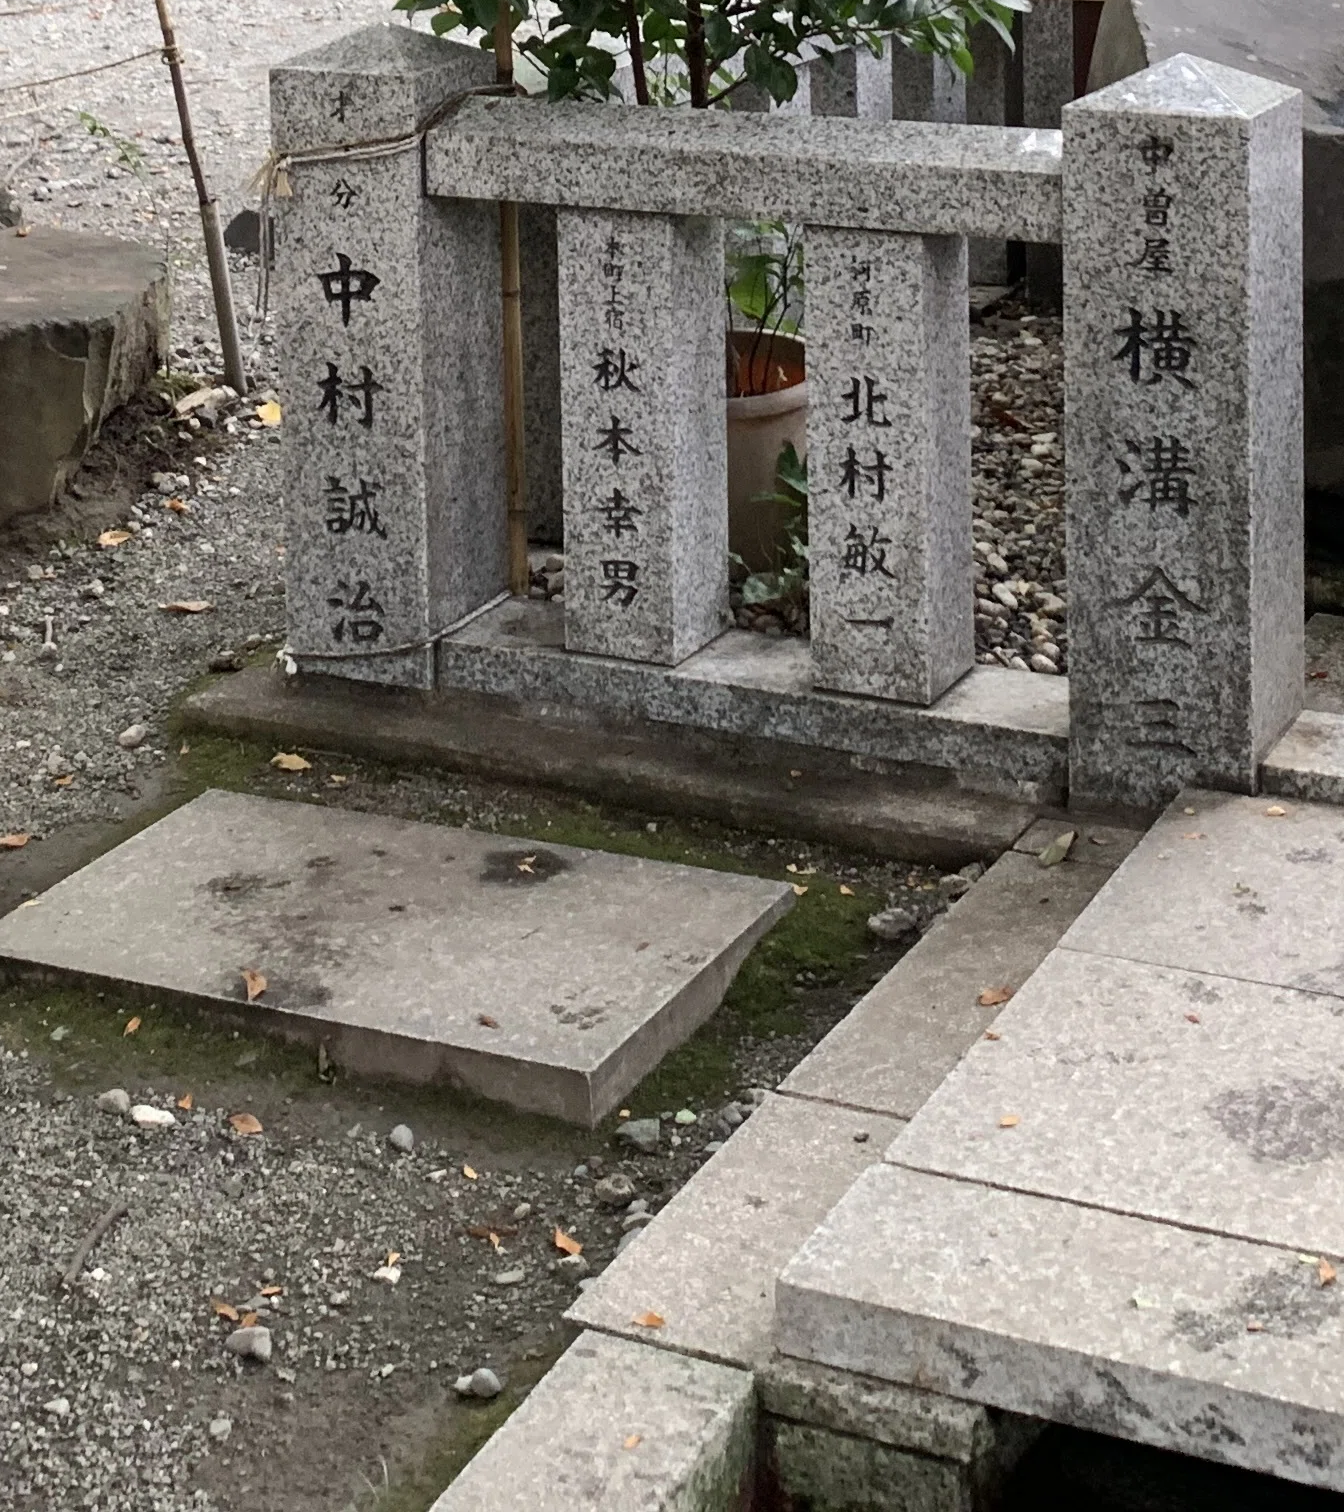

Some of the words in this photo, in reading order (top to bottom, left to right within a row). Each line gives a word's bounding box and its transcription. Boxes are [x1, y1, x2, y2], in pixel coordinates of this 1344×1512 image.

[329, 90, 359, 209] 才分
[316, 252, 388, 642] 中村誠治
[591, 347, 644, 609] 秋本幸男
[839, 375, 899, 629] 北村敏一
